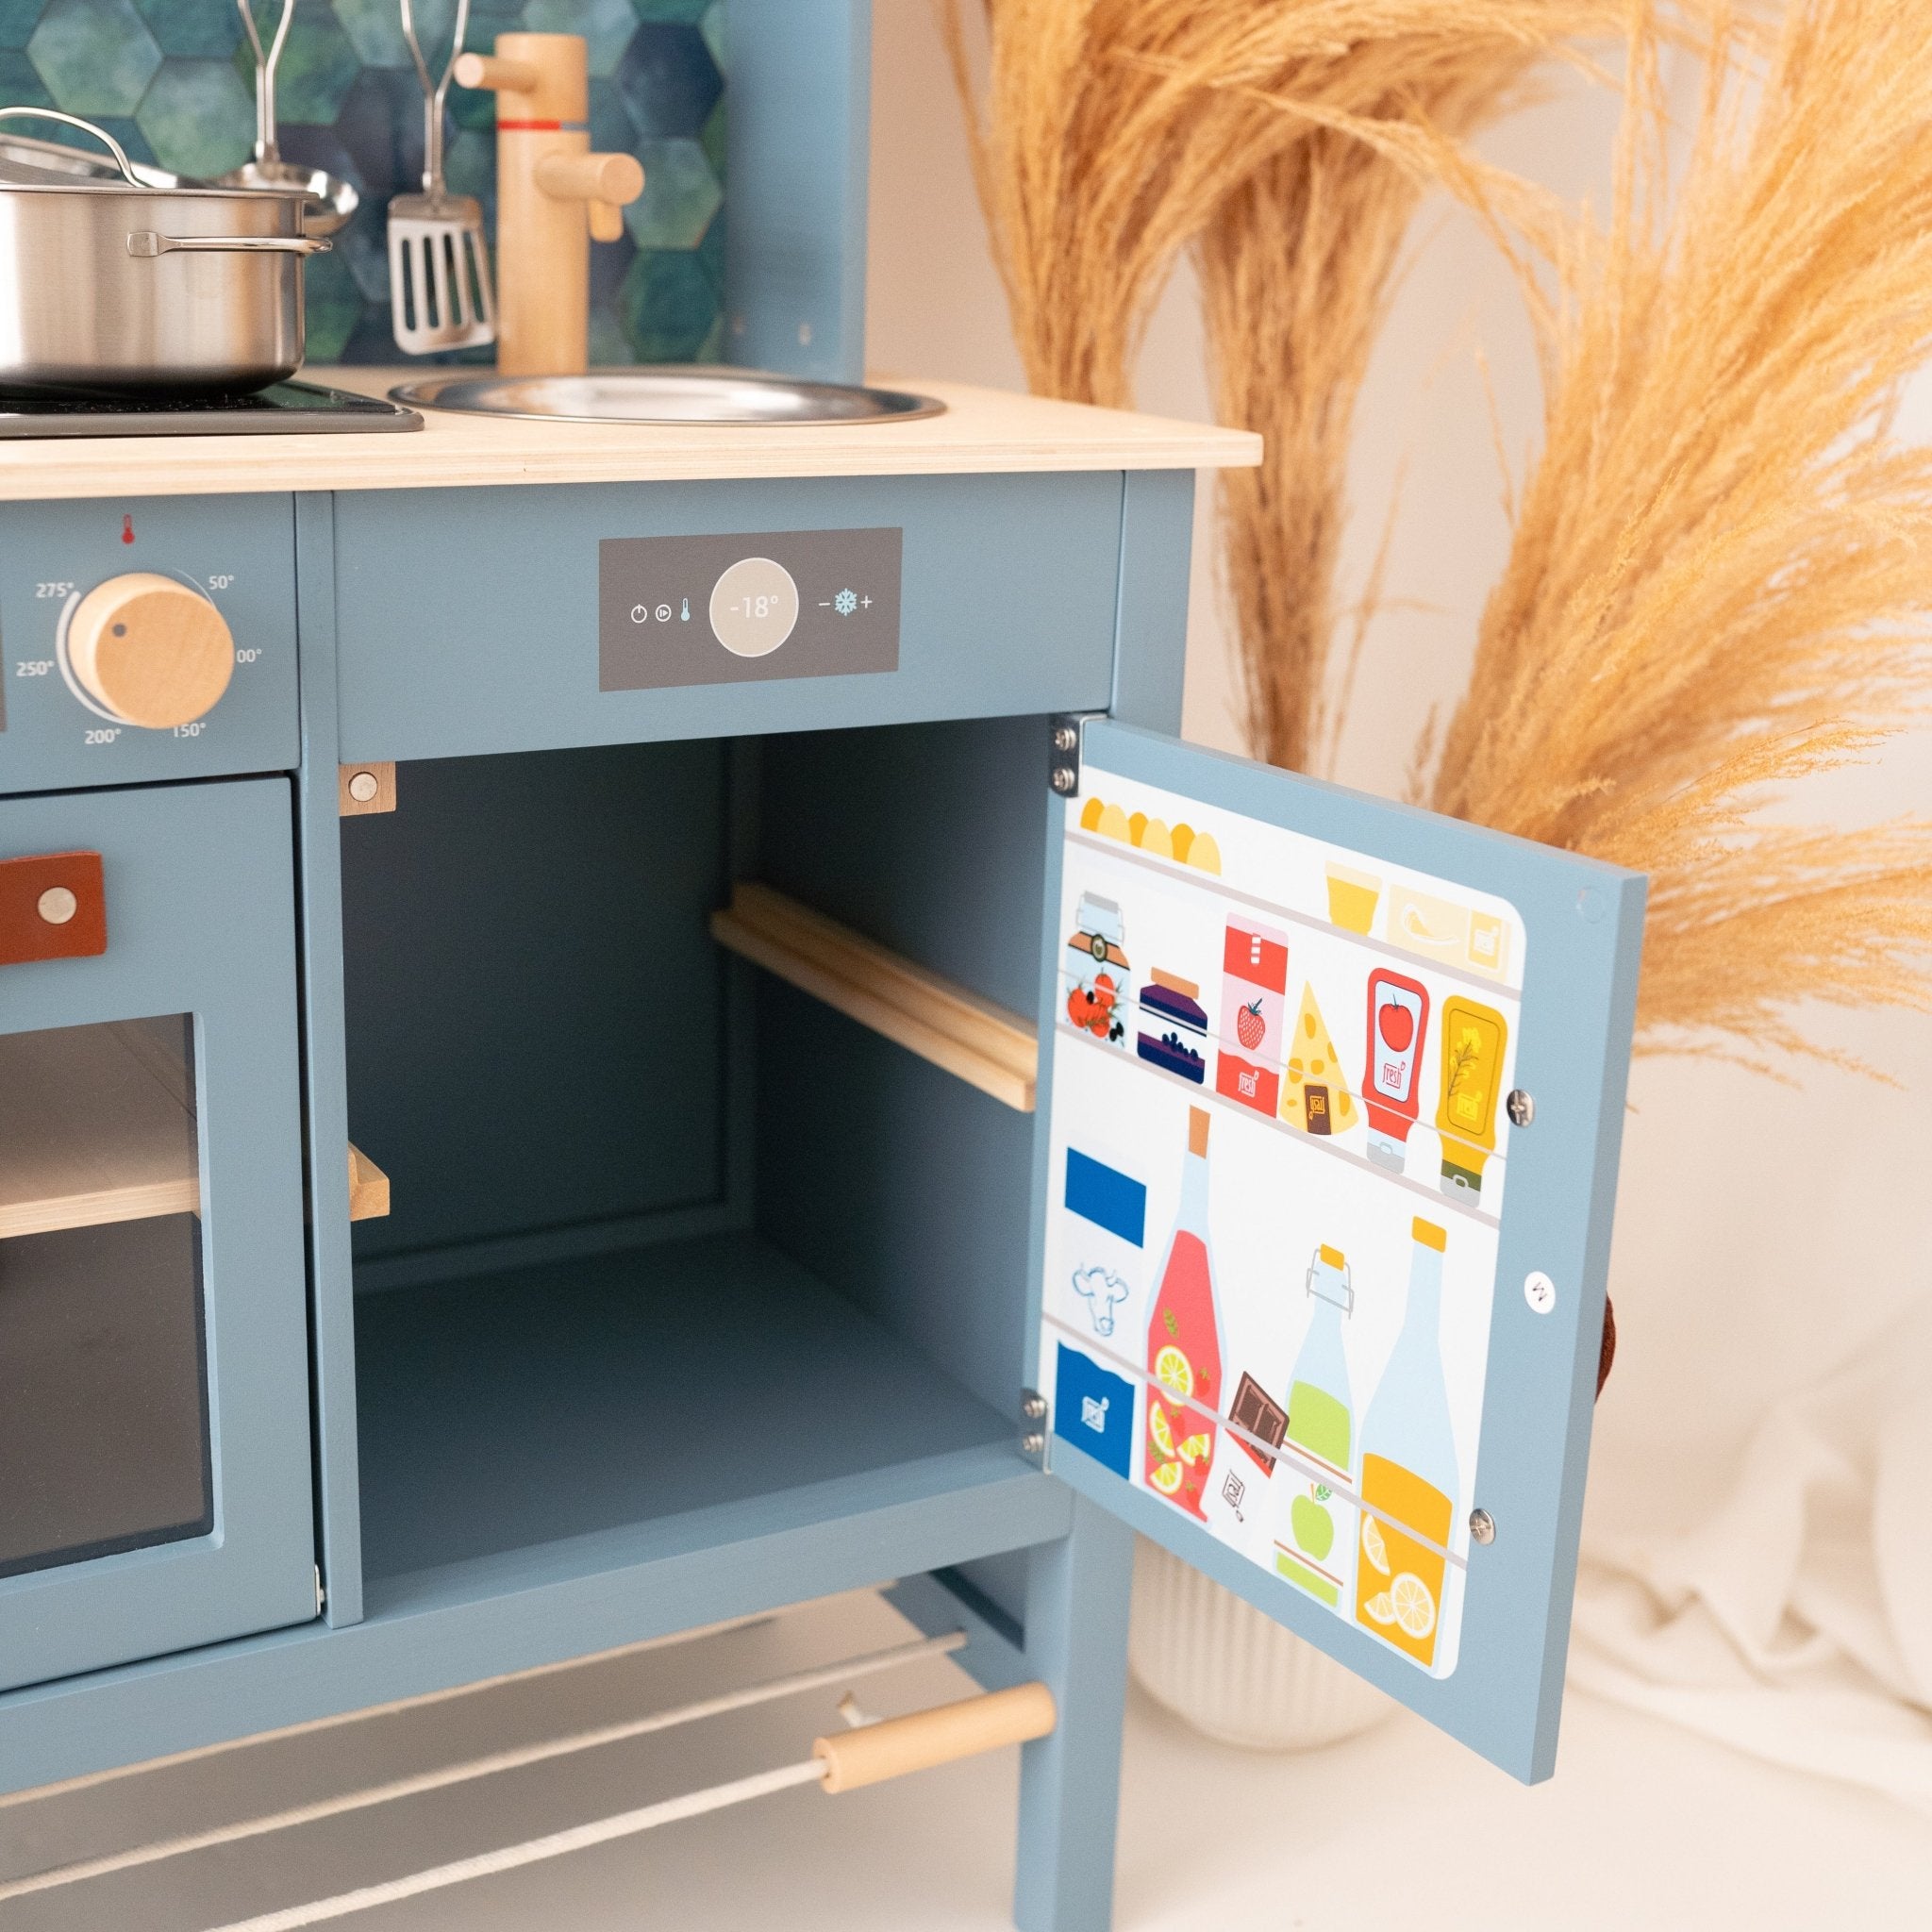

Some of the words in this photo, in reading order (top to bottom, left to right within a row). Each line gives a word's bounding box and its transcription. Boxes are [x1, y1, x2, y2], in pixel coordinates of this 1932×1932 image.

[35, 582, 75, 598] 275°
[730, 595, 778, 619] -18°
[236, 648, 262, 663] 00°
[16, 659, 55, 677] 250°
[85, 728, 122, 745] 200°
